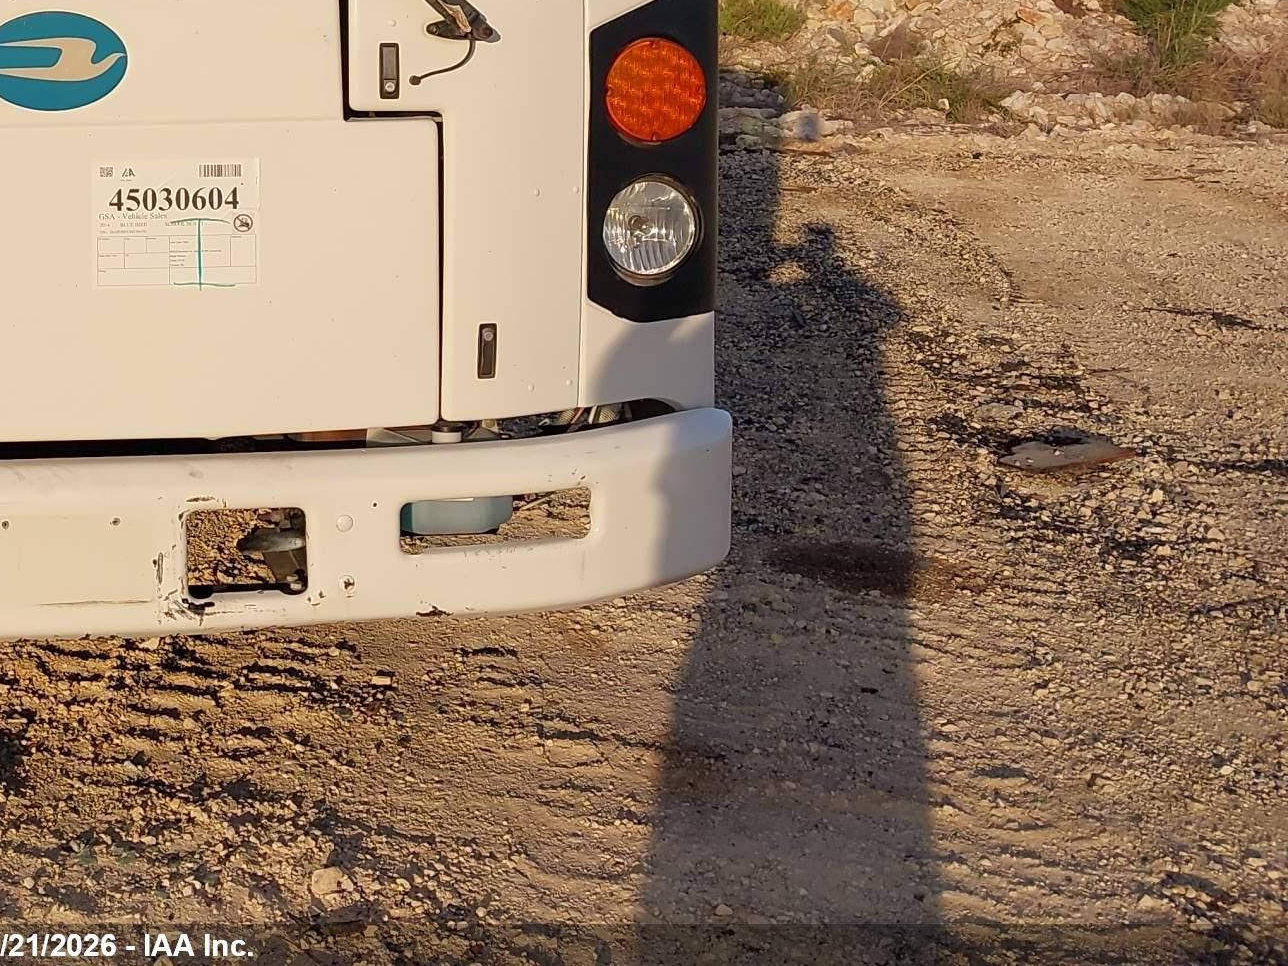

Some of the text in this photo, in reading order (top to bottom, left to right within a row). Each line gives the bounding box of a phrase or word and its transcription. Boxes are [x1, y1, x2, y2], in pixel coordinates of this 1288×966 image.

[108, 186, 239, 212] 45030604
[122, 212, 148, 220] Vehicle
[149, 212, 168, 220] Sales
